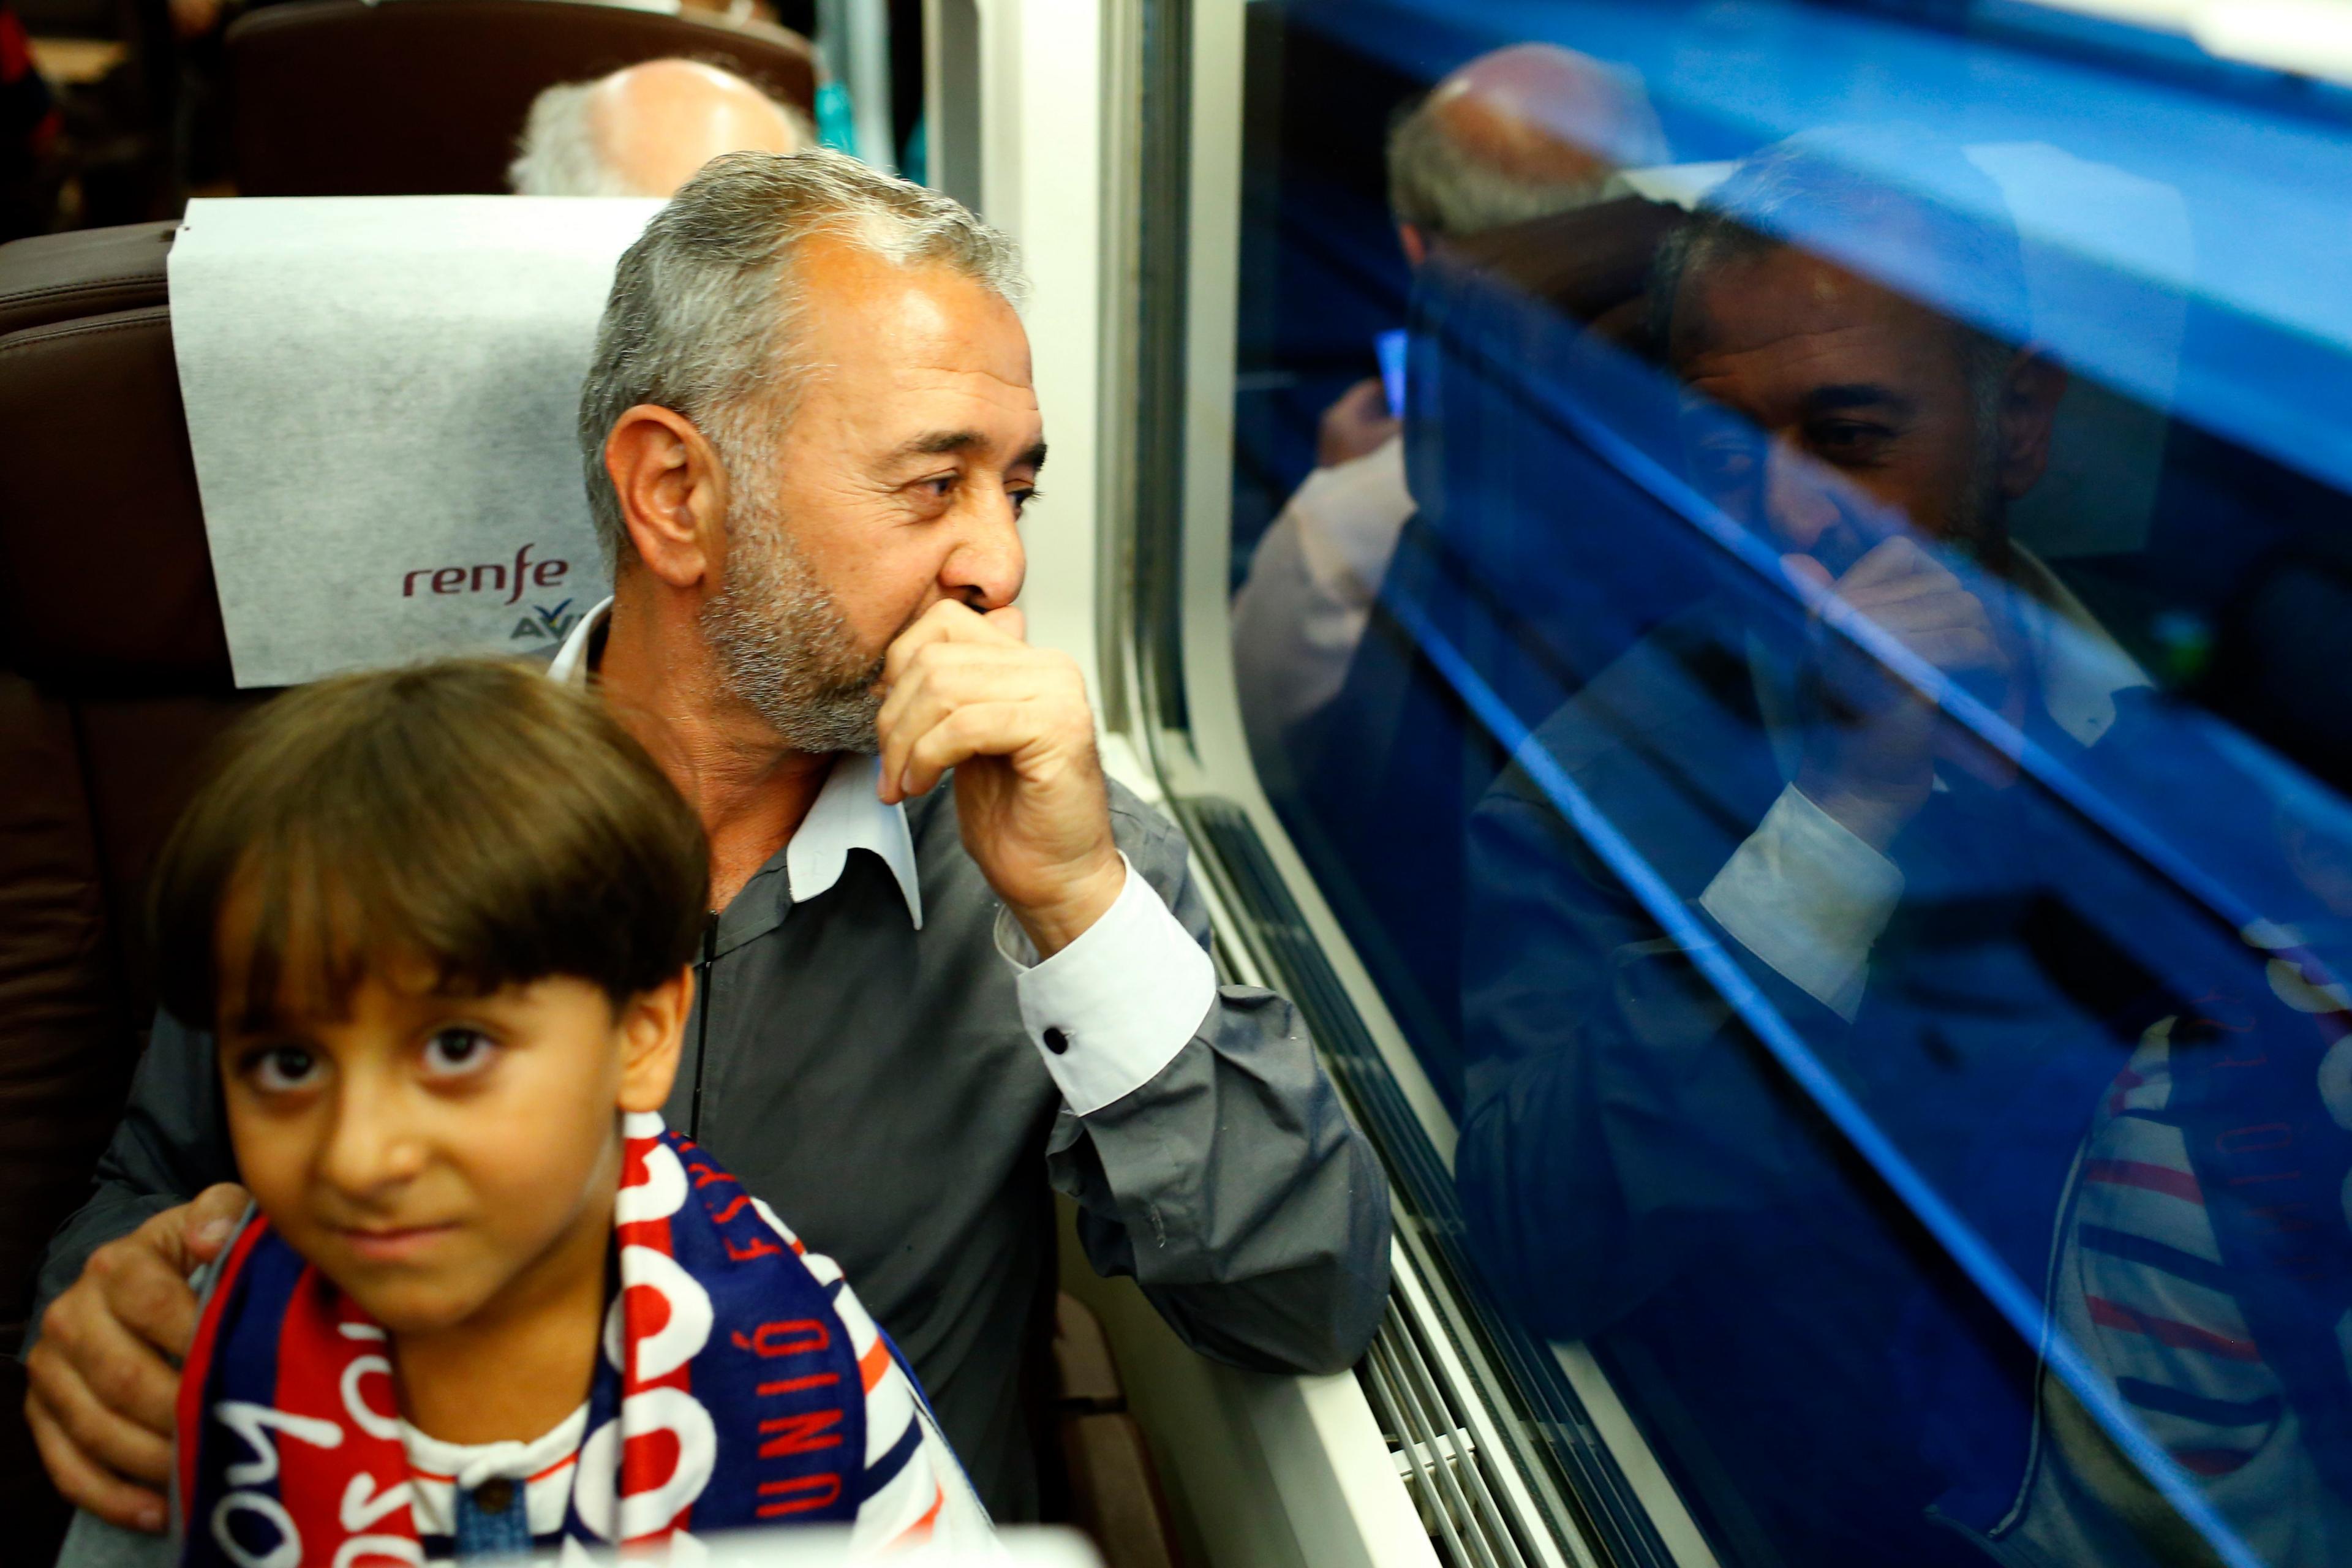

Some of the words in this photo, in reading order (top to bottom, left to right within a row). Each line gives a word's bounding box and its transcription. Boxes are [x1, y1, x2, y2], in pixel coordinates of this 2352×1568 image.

[402, 543, 568, 605] renfe
[510, 611, 585, 639] AV
[731, 1319, 843, 1518] UNIÓ
